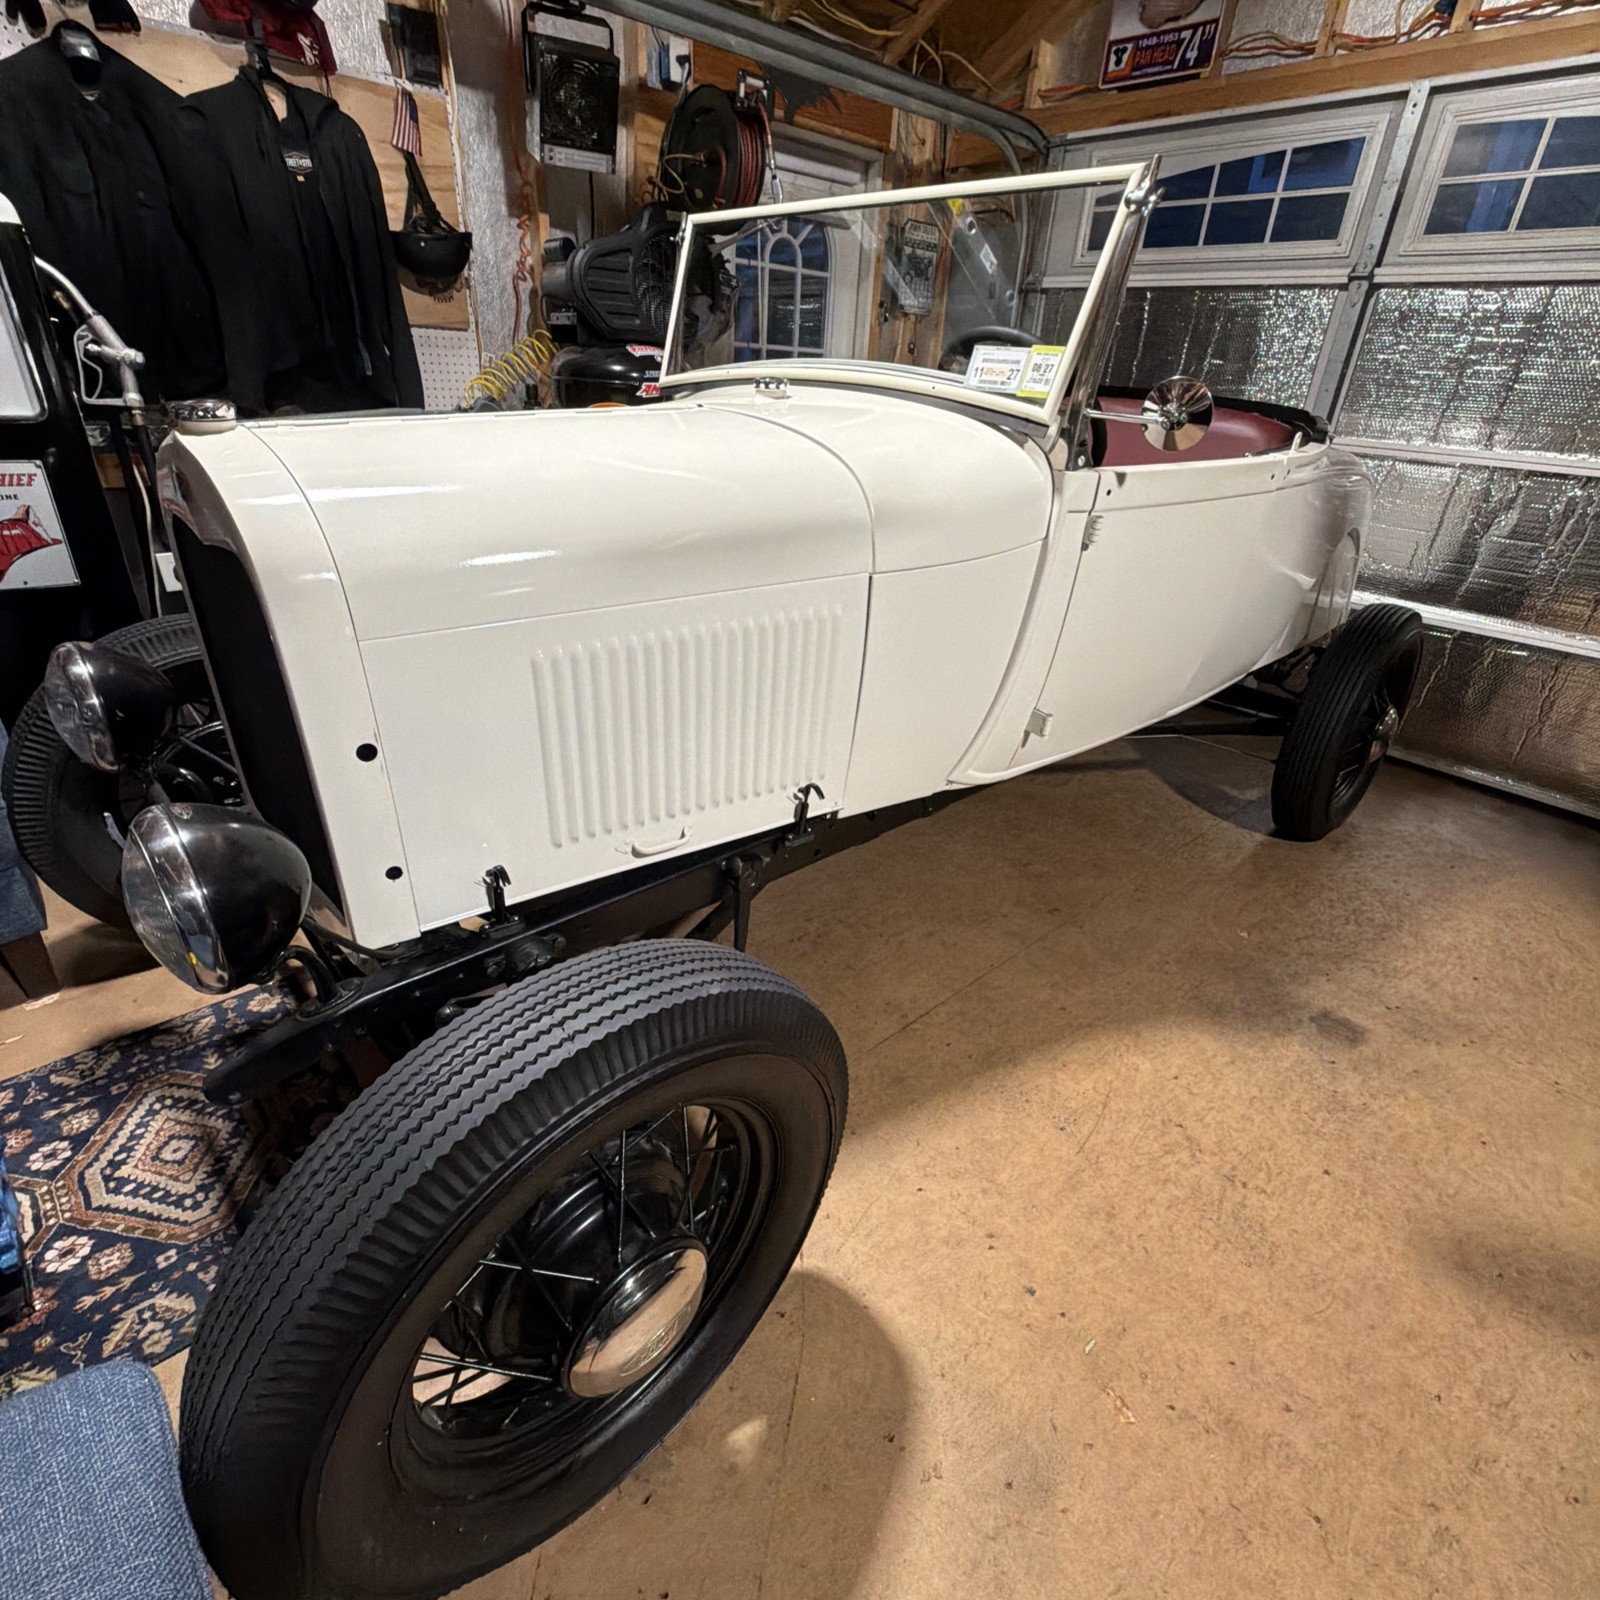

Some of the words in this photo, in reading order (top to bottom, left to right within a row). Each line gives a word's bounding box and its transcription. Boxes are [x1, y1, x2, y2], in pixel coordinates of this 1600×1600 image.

[1134, 47, 1152, 67] PAN
[1152, 44, 1178, 64] HEAD
[973, 366, 985, 379] 11
[1006, 368, 1021, 381] 27
[1043, 363, 1055, 375] 27
